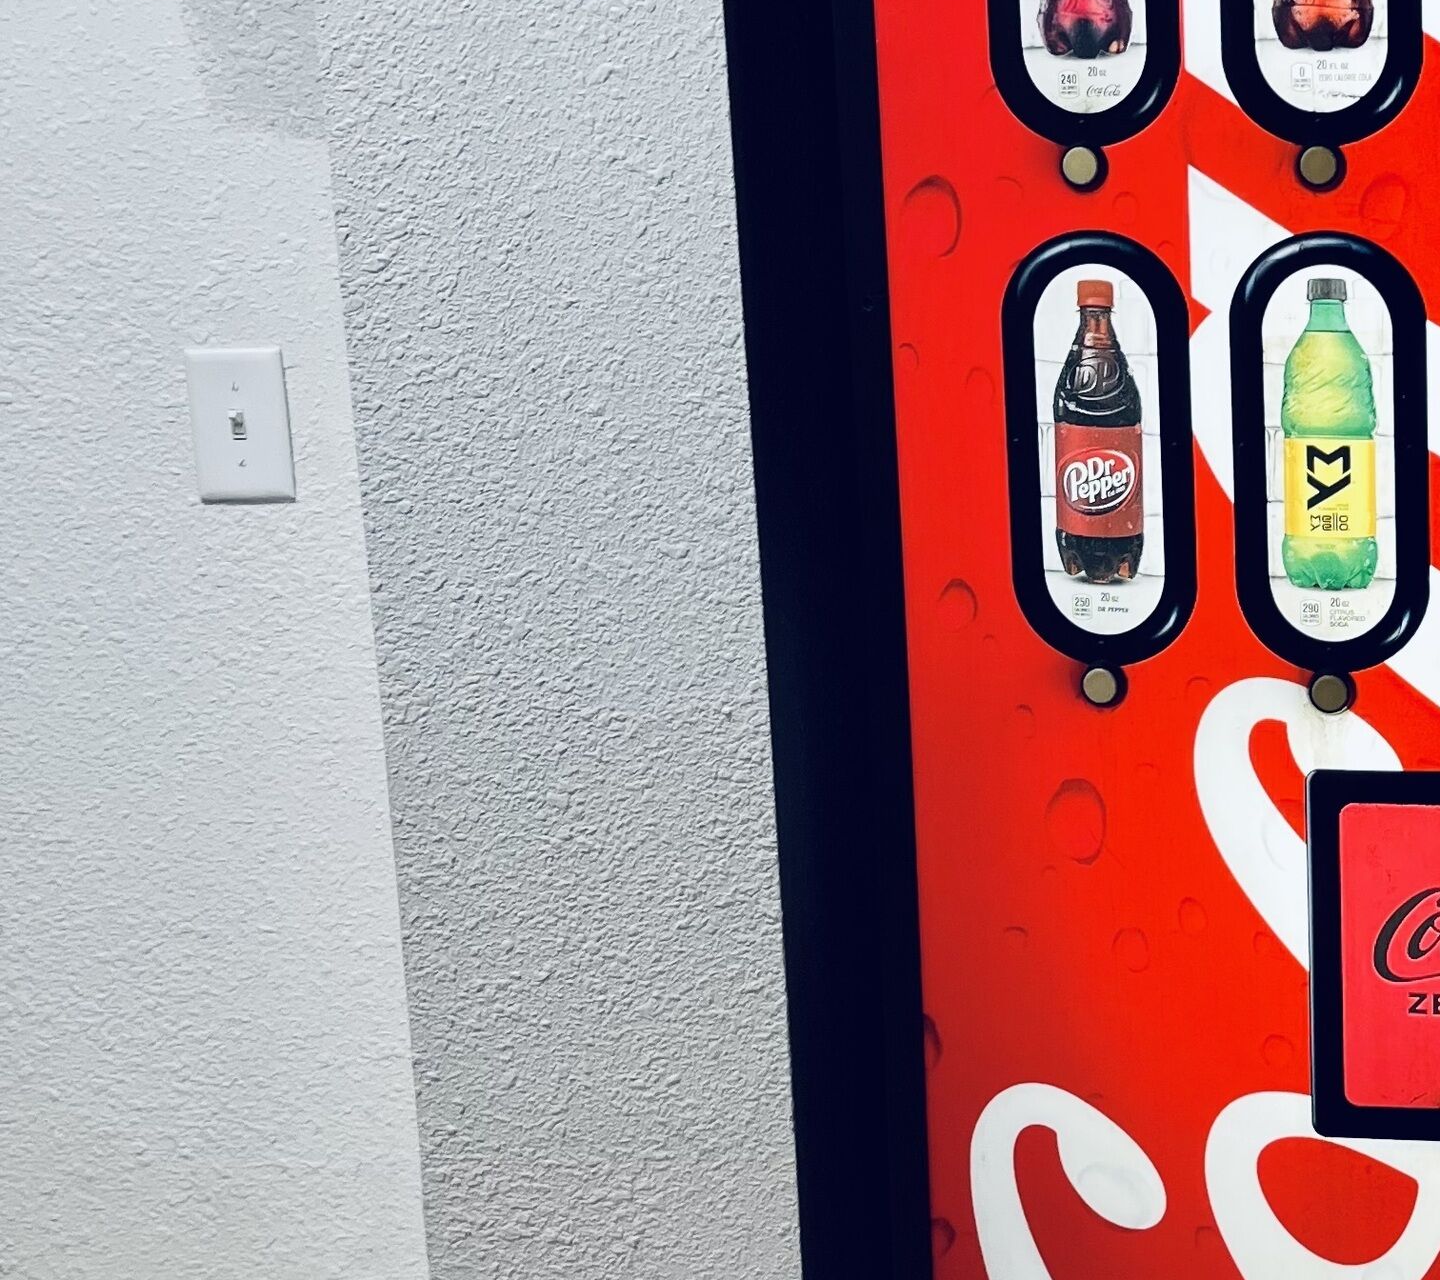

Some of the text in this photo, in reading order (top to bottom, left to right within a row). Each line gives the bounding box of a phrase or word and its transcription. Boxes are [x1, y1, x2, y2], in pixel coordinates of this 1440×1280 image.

[1316, 59, 1327, 70] 20
[1087, 66, 1098, 77] 20
[1060, 74, 1077, 85] 240
[1086, 456, 1116, 480] Dr
[1065, 461, 1132, 503] Pepper
[1074, 596, 1091, 607] 250
[1302, 602, 1319, 614] 290
